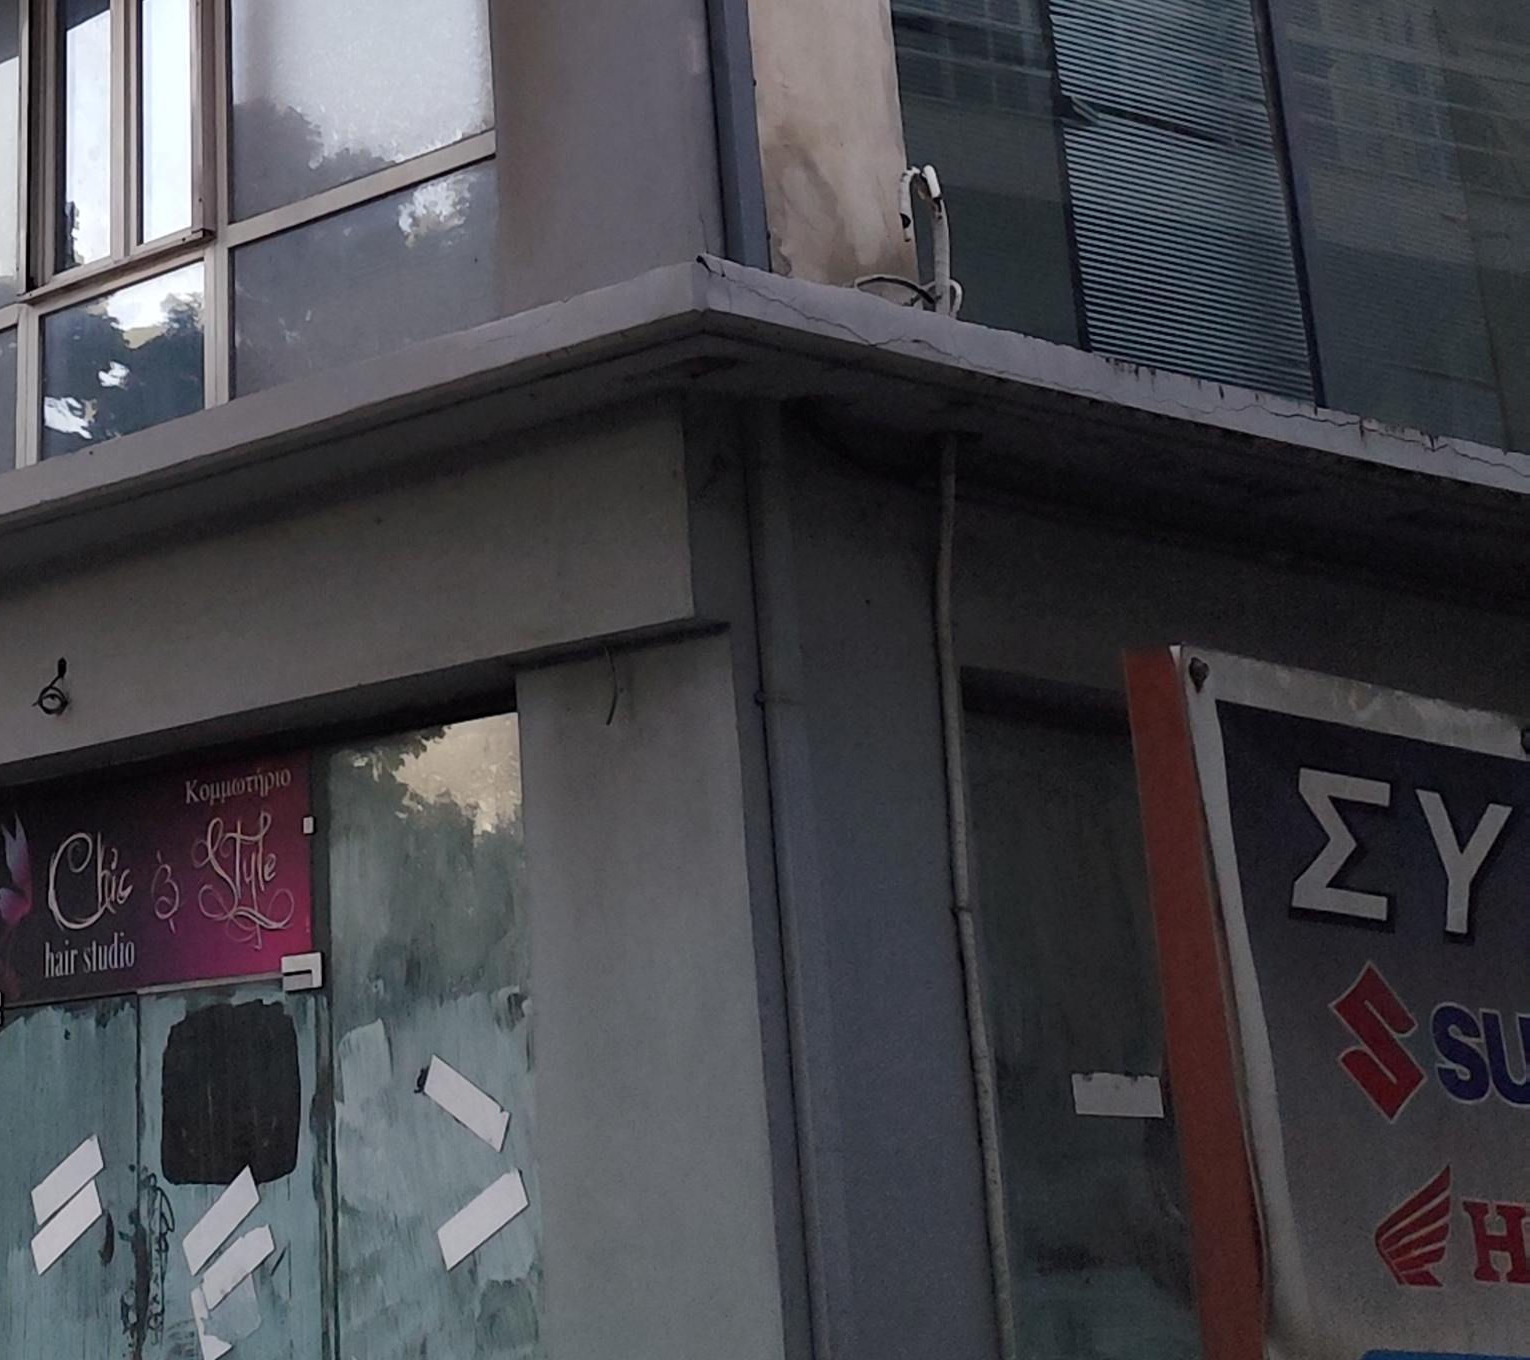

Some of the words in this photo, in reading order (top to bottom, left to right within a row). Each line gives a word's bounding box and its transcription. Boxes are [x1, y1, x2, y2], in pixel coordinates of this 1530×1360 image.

[185, 768, 292, 807] Κομμωτήριο
[47, 831, 134, 931] Chic
[44, 939, 79, 978] hair
[82, 932, 136, 974] studio
